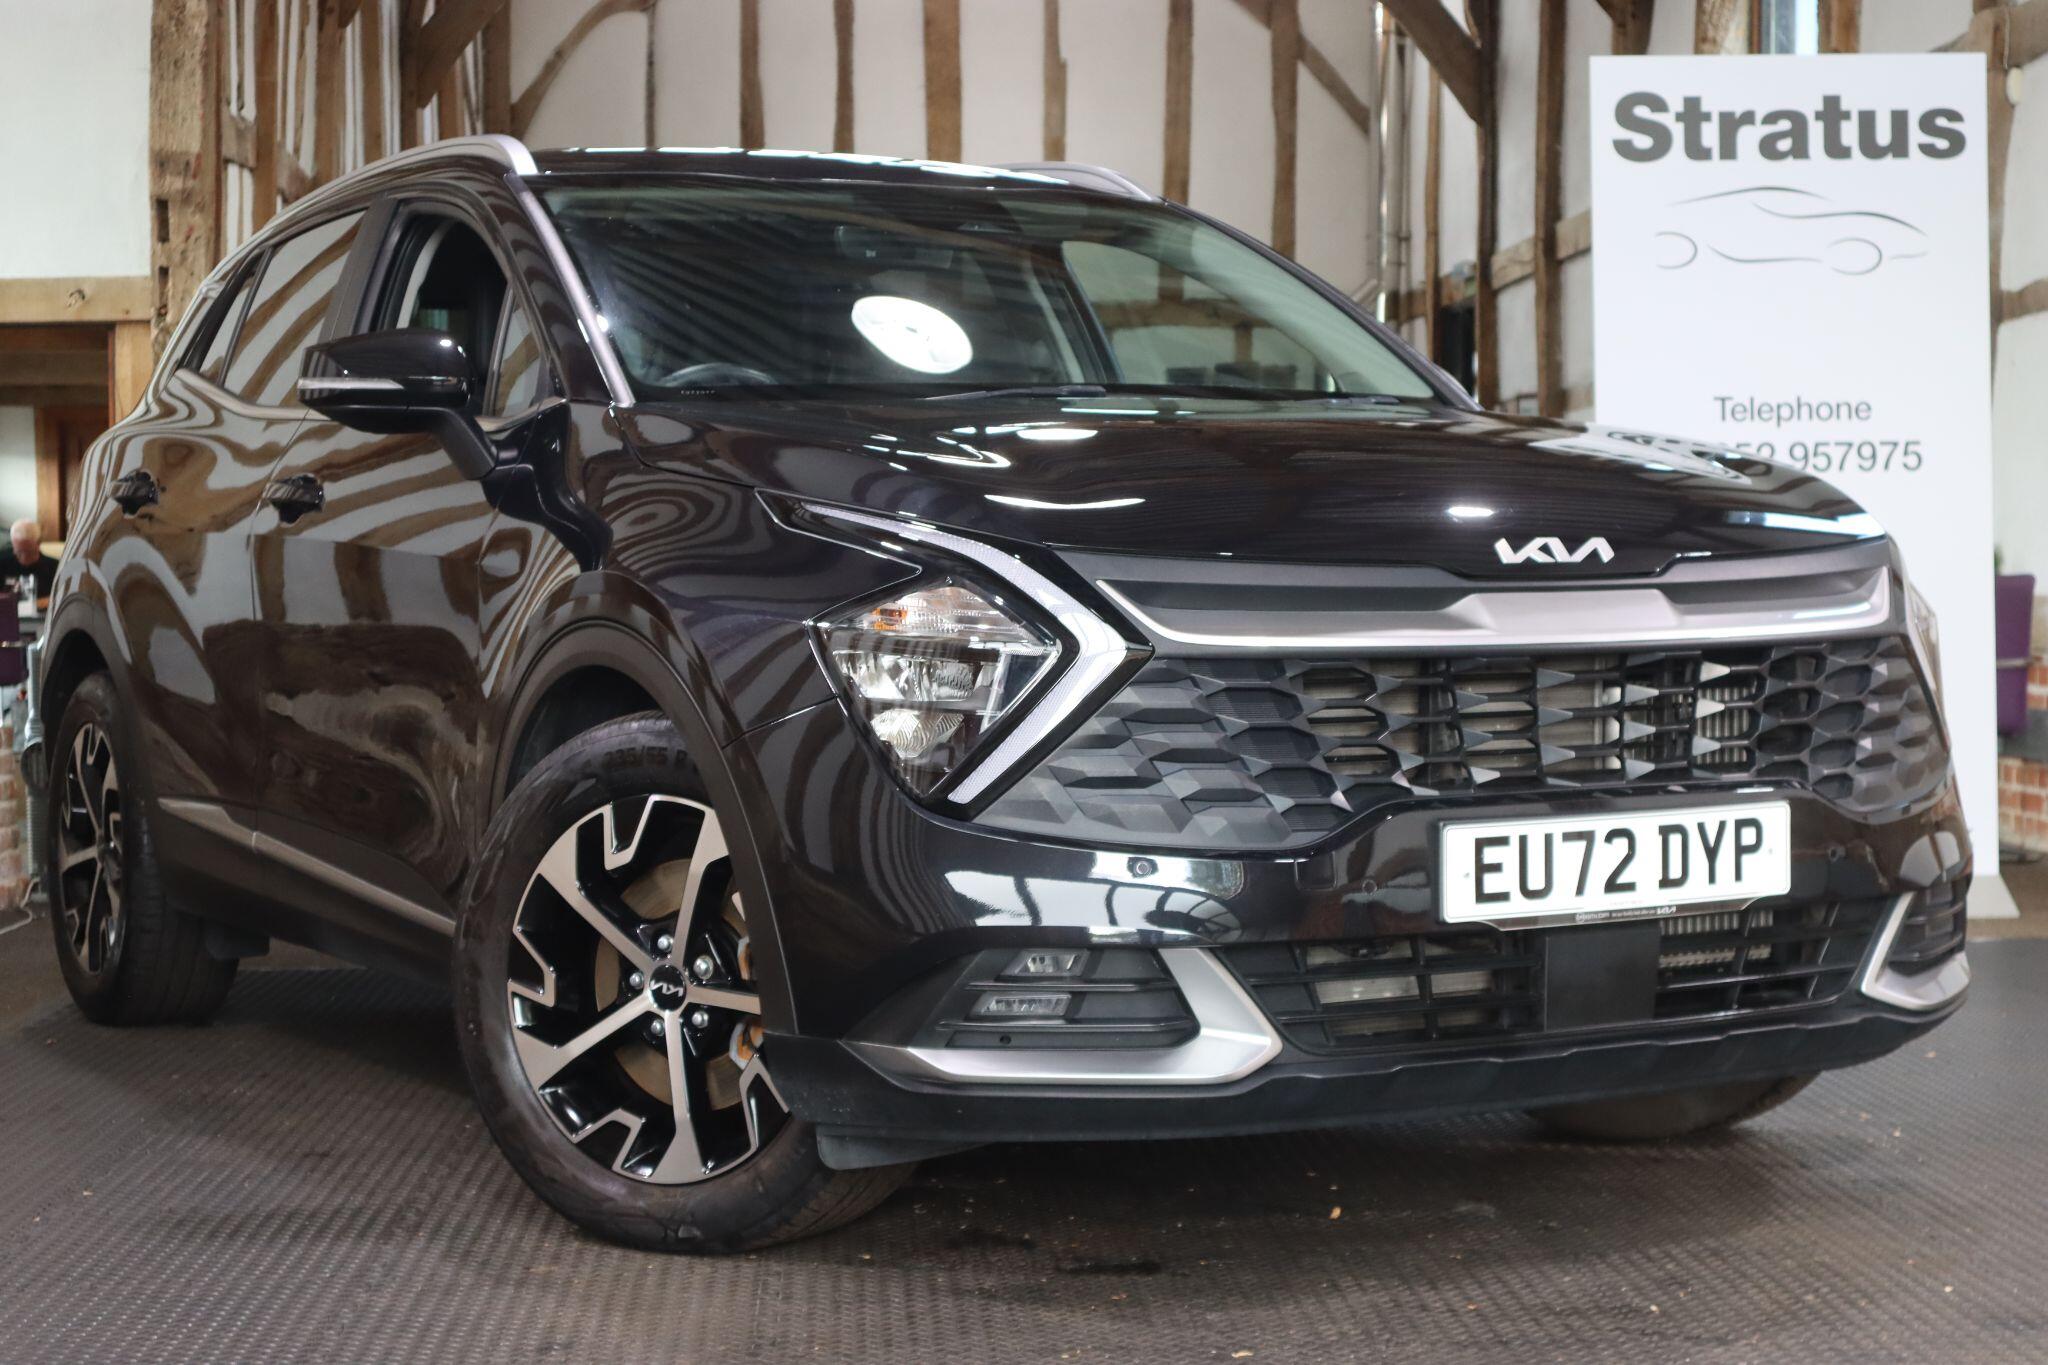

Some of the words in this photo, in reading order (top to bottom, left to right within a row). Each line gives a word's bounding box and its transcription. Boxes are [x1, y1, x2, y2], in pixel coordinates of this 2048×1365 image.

[1612, 91, 1967, 163] Stratus
[1713, 396, 1873, 428] Telephone
[1789, 441, 1923, 472] 957975
[1494, 536, 1615, 565] KIA
[1474, 828, 1637, 904] EU72
[1658, 817, 1764, 890] DYP
